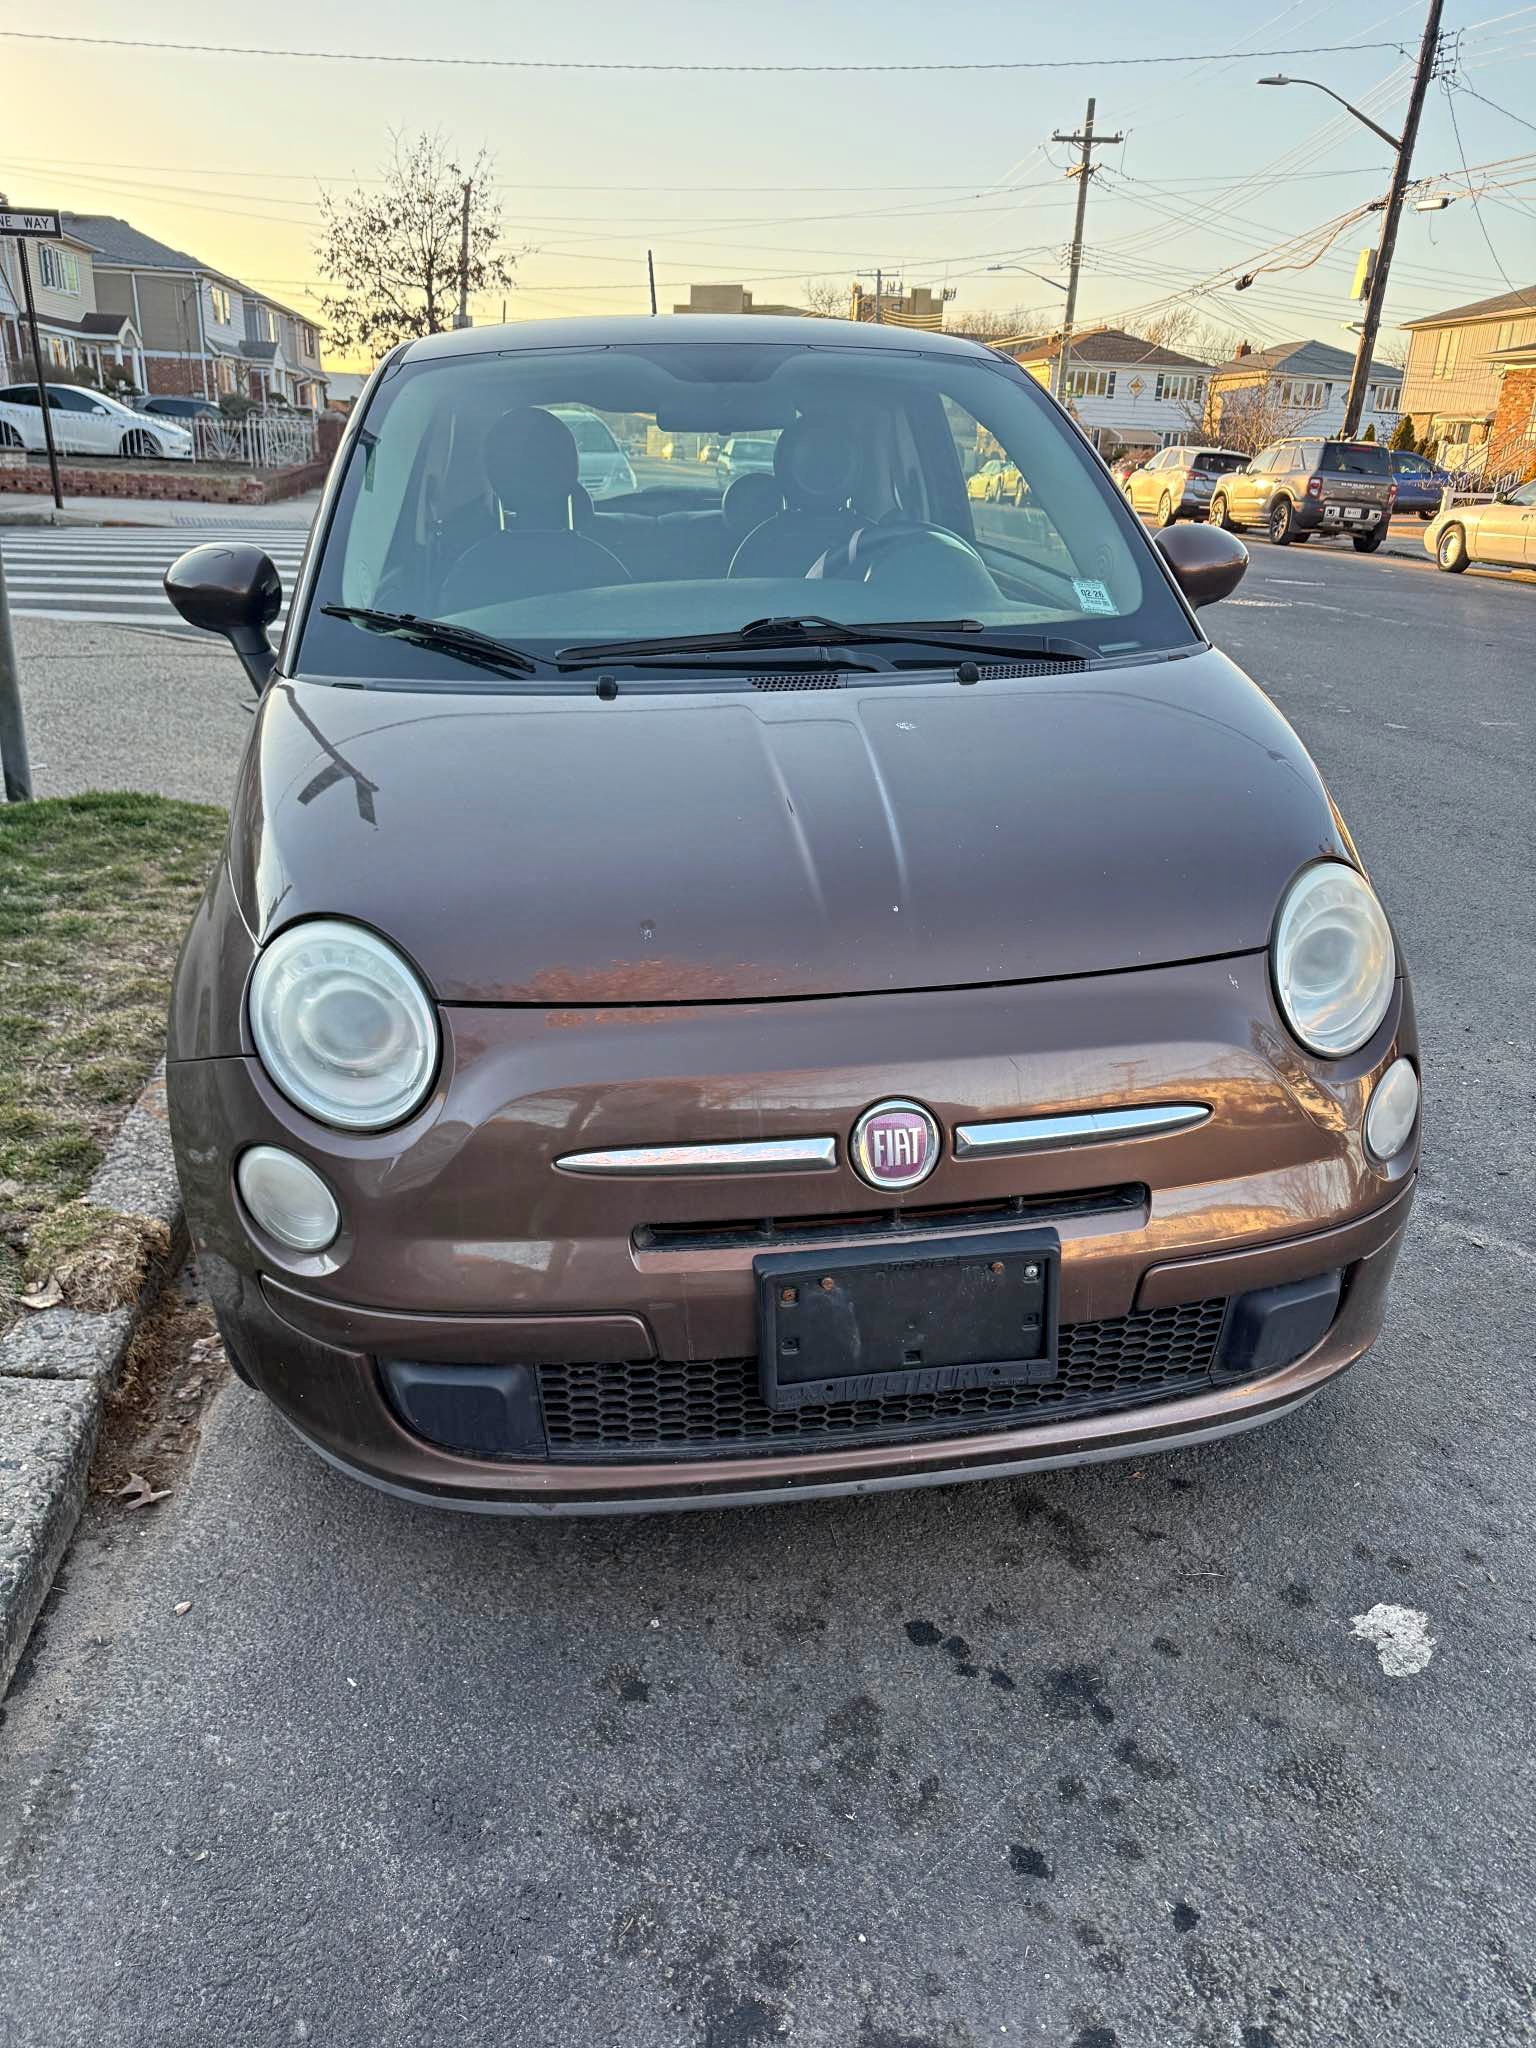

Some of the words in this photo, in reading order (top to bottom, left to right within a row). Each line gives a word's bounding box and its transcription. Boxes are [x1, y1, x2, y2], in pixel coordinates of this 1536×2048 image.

[0, 215, 12, 227] NE
[23, 216, 49, 230] WAY
[872, 1126, 922, 1169] FIAT
